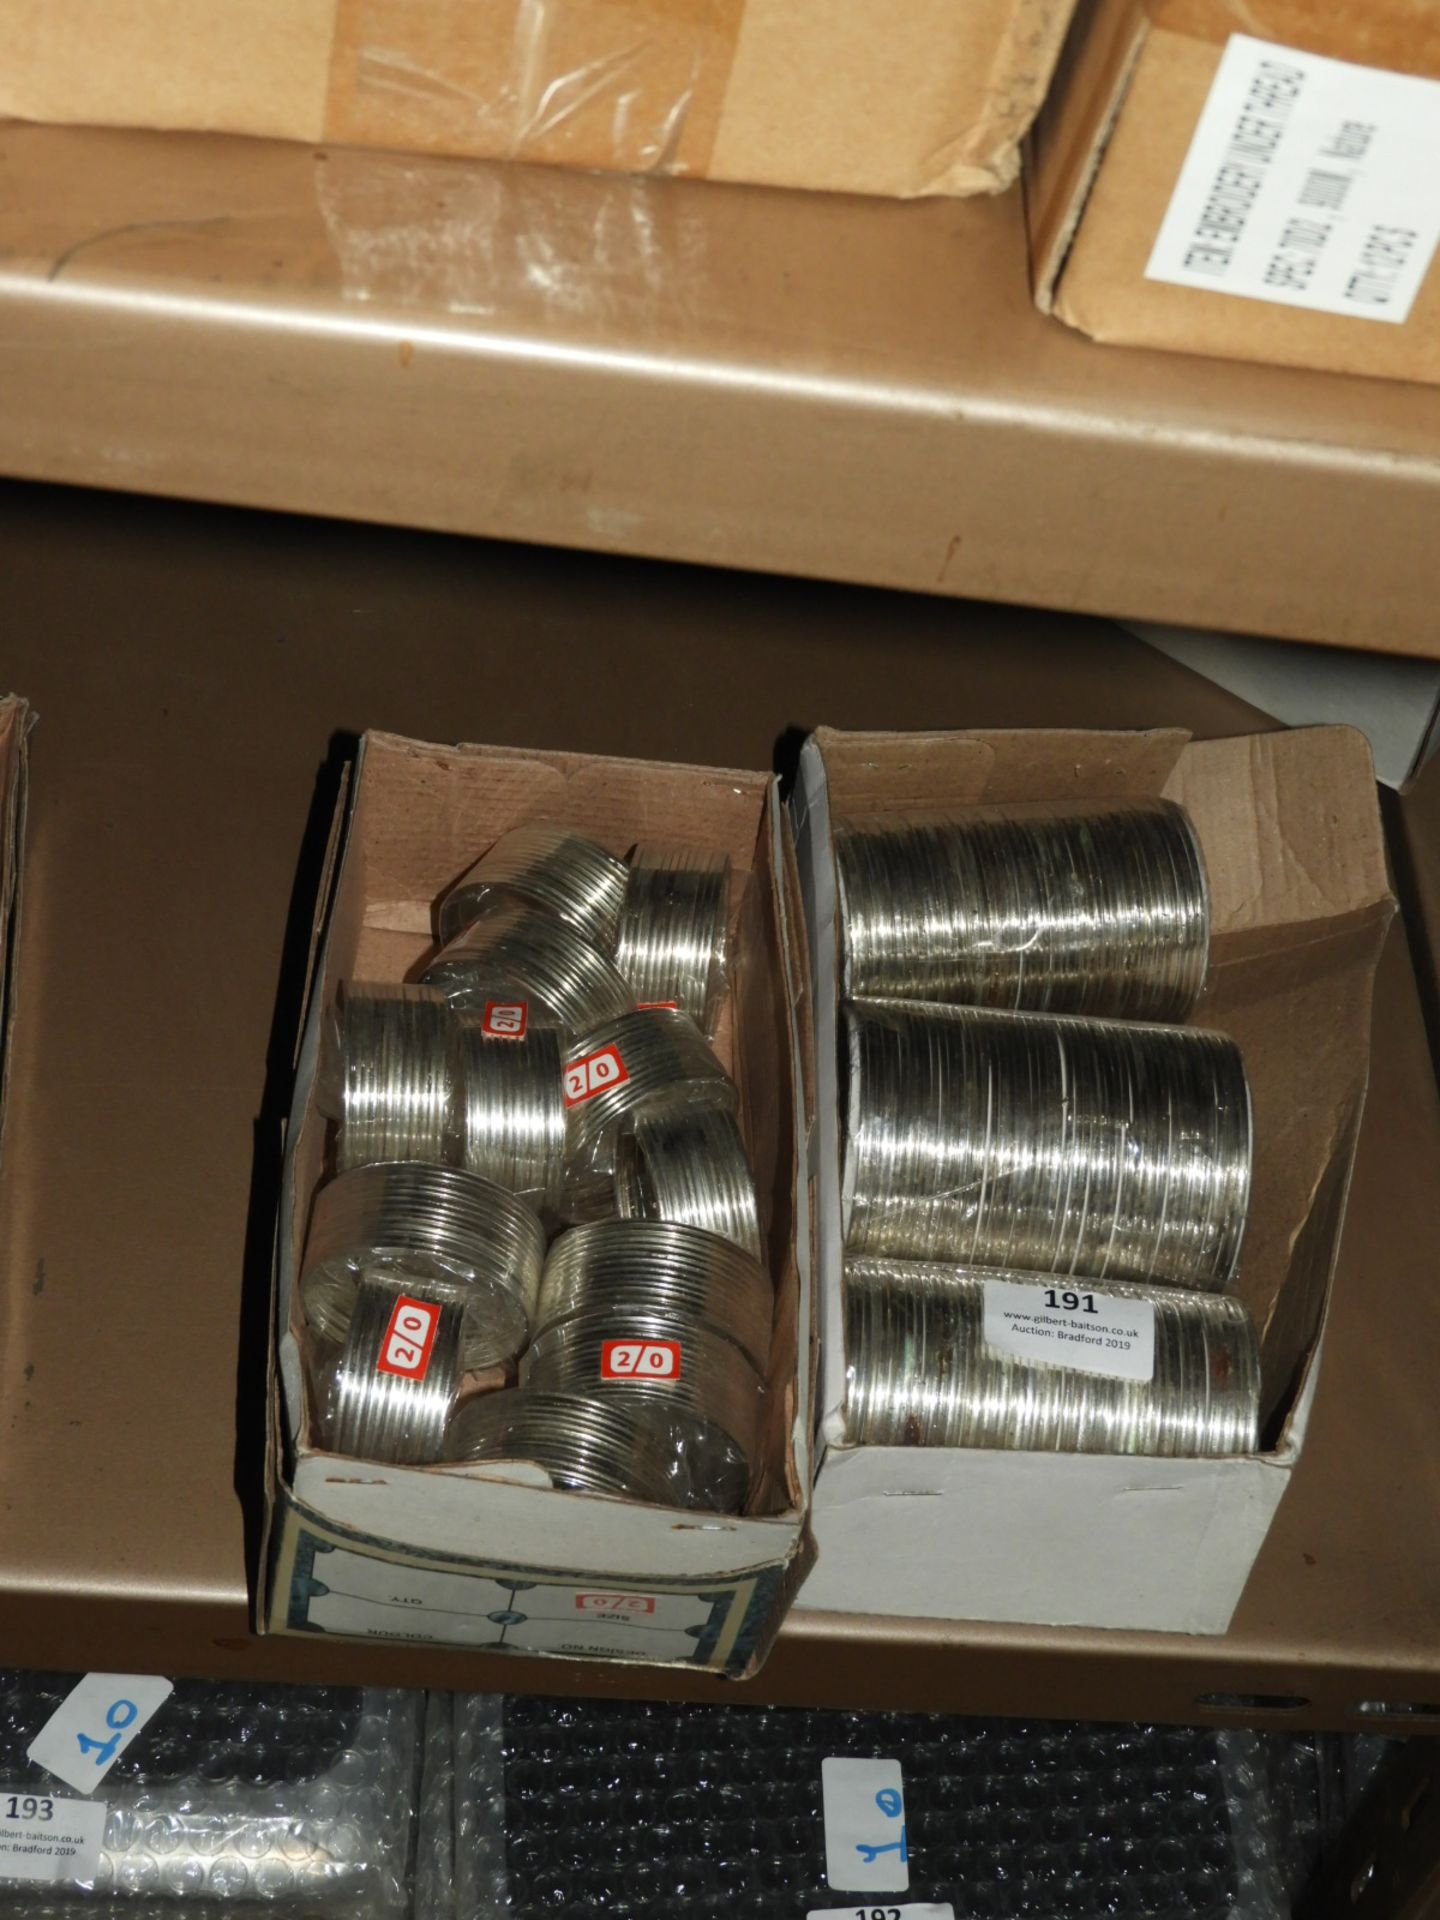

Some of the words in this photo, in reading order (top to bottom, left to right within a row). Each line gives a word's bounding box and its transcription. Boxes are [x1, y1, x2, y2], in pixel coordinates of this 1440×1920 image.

[1244, 60, 1306, 117] THREAD
[491, 1008, 521, 1030] 2/0
[568, 1061, 610, 1094] 2/0
[1044, 1289, 1099, 1314] 191
[1003, 1311, 1140, 1338] www.gilbert-baitson.co.uk
[1011, 1323, 1055, 1338] Auction:
[1057, 1330, 1103, 1346] Bradford
[1105, 1337, 1131, 1351] 2019
[392, 1315, 422, 1363] 2/0
[616, 1347, 664, 1371] 2/0
[593, 1597, 644, 1610] 2/0
[597, 1613, 631, 1621] SIZE
[77, 1699, 138, 1767] 10
[5, 1796, 54, 1822] 193
[855, 1788, 908, 1863] 10
[12, 1843, 53, 1856] Bradford
[54, 1847, 77, 1856] 2019
